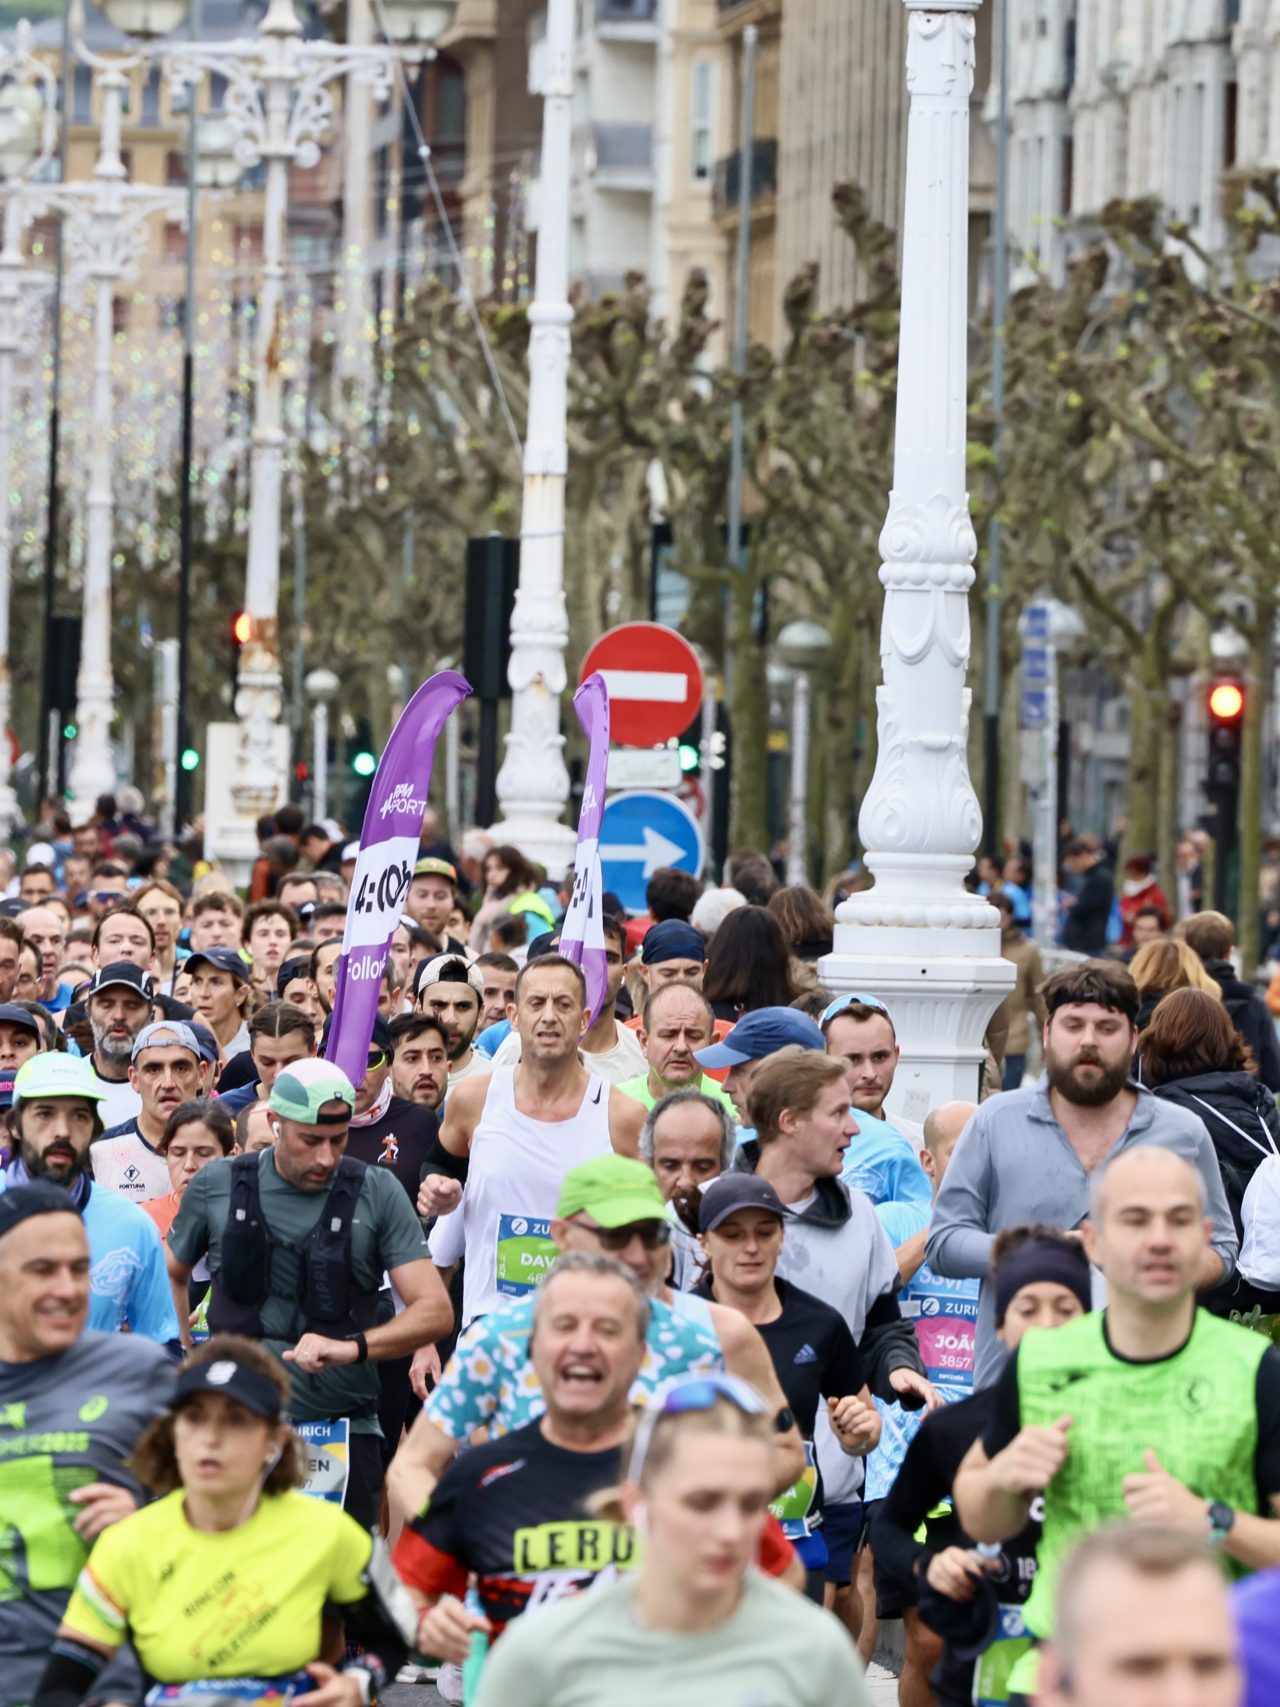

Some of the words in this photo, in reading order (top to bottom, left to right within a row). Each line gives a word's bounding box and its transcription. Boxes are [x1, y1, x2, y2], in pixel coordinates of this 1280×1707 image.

[118, 1182, 146, 1190] FORTUNA
[520, 1252, 557, 1269] DAV
[934, 1334, 975, 1352] JOÃ
[939, 1354, 971, 1369] 3857
